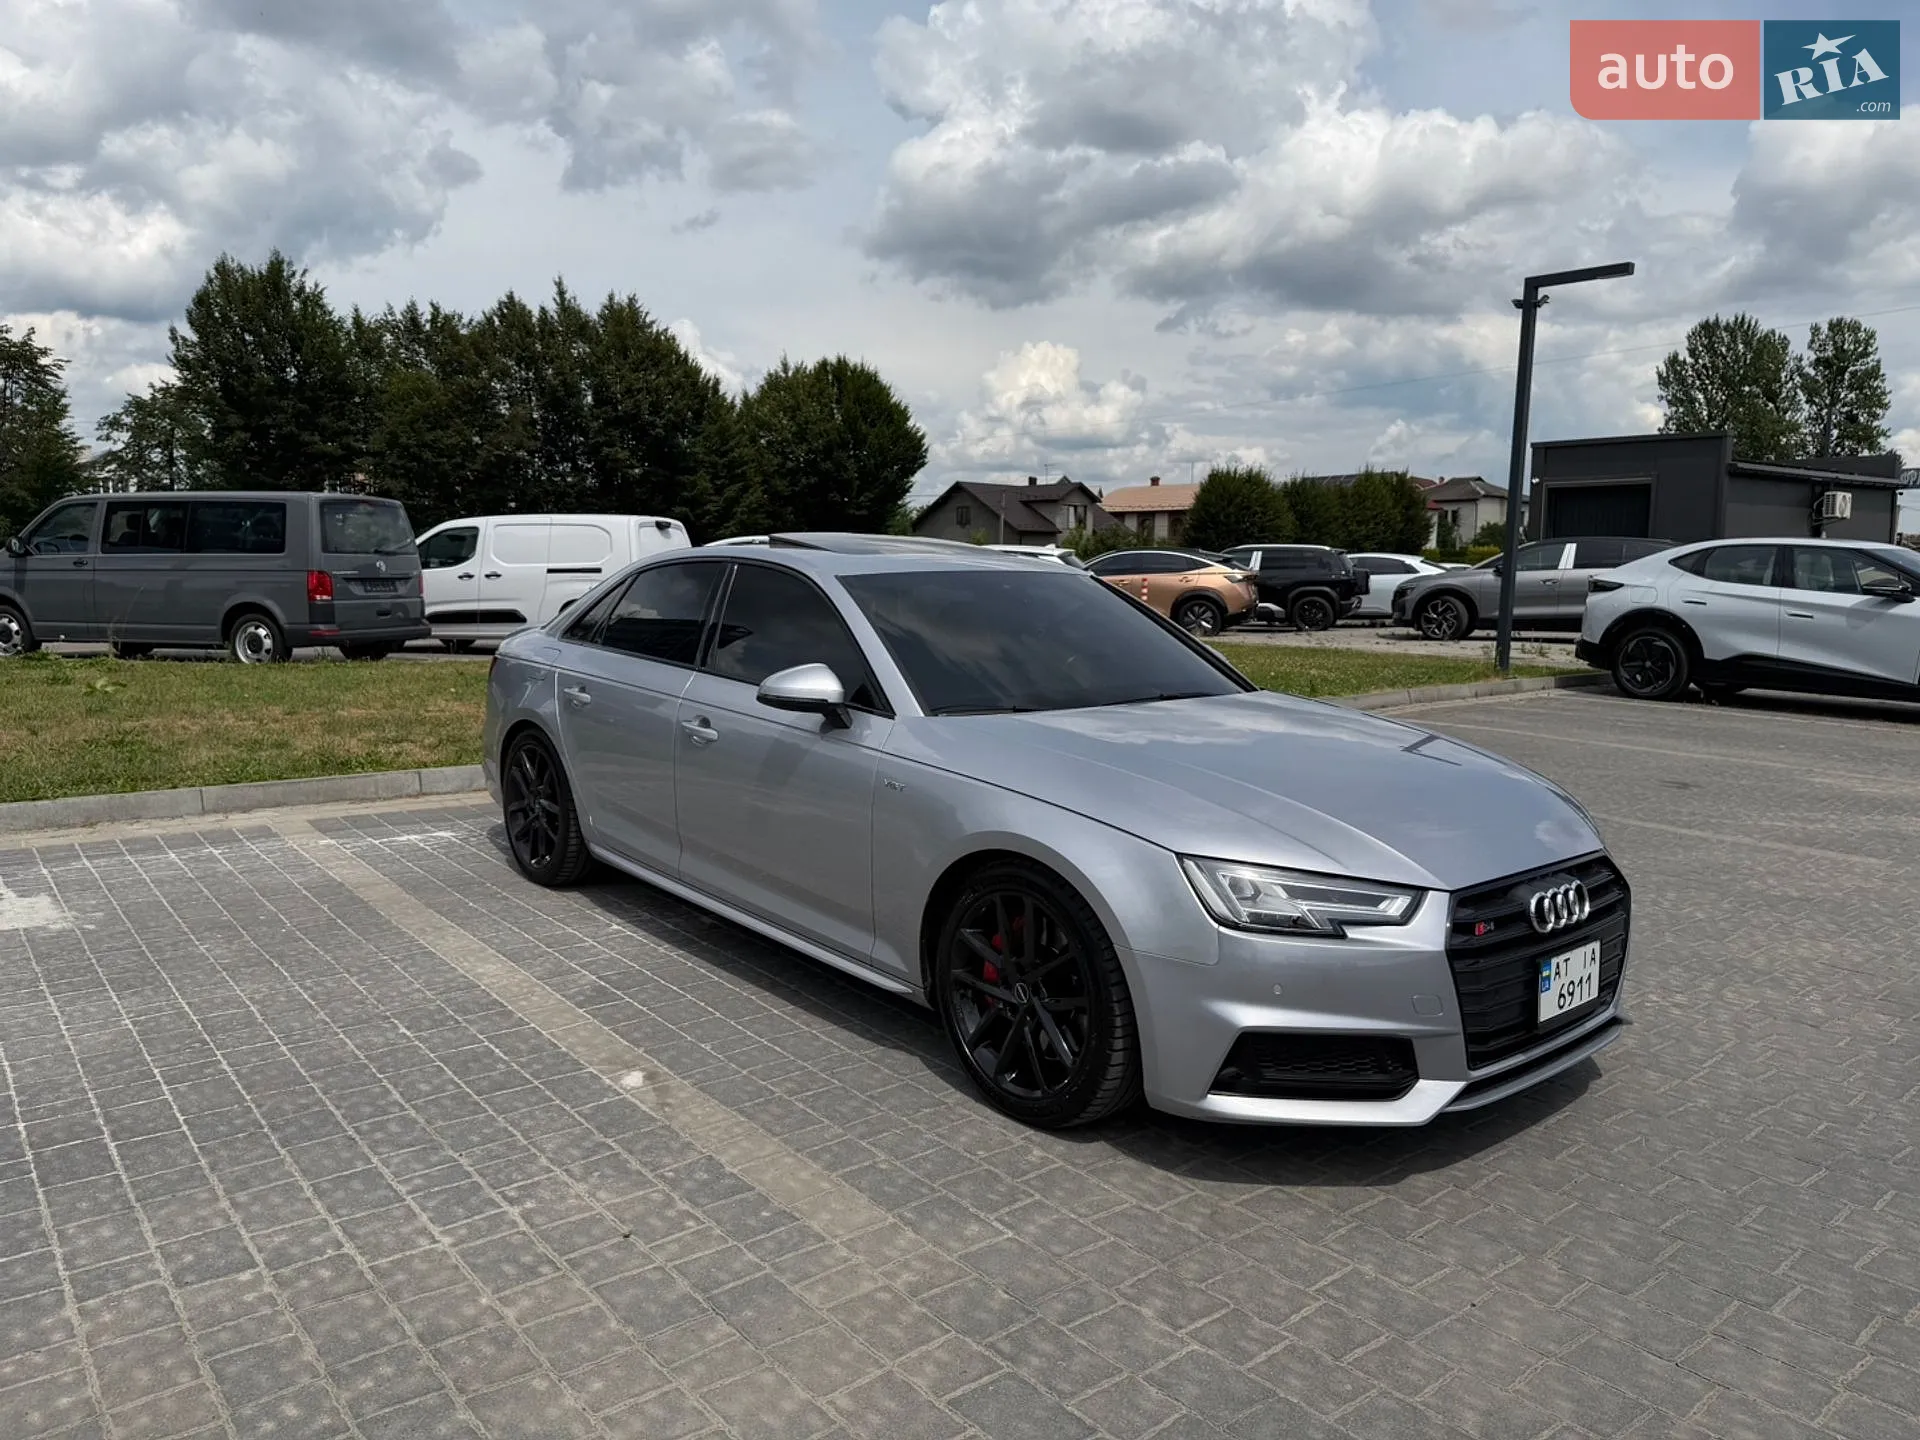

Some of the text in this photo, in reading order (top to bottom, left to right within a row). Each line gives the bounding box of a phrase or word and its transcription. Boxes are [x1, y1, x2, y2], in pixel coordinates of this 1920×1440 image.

[1554, 948, 1596, 981] AT IA
[1557, 972, 1592, 1011] 6911
